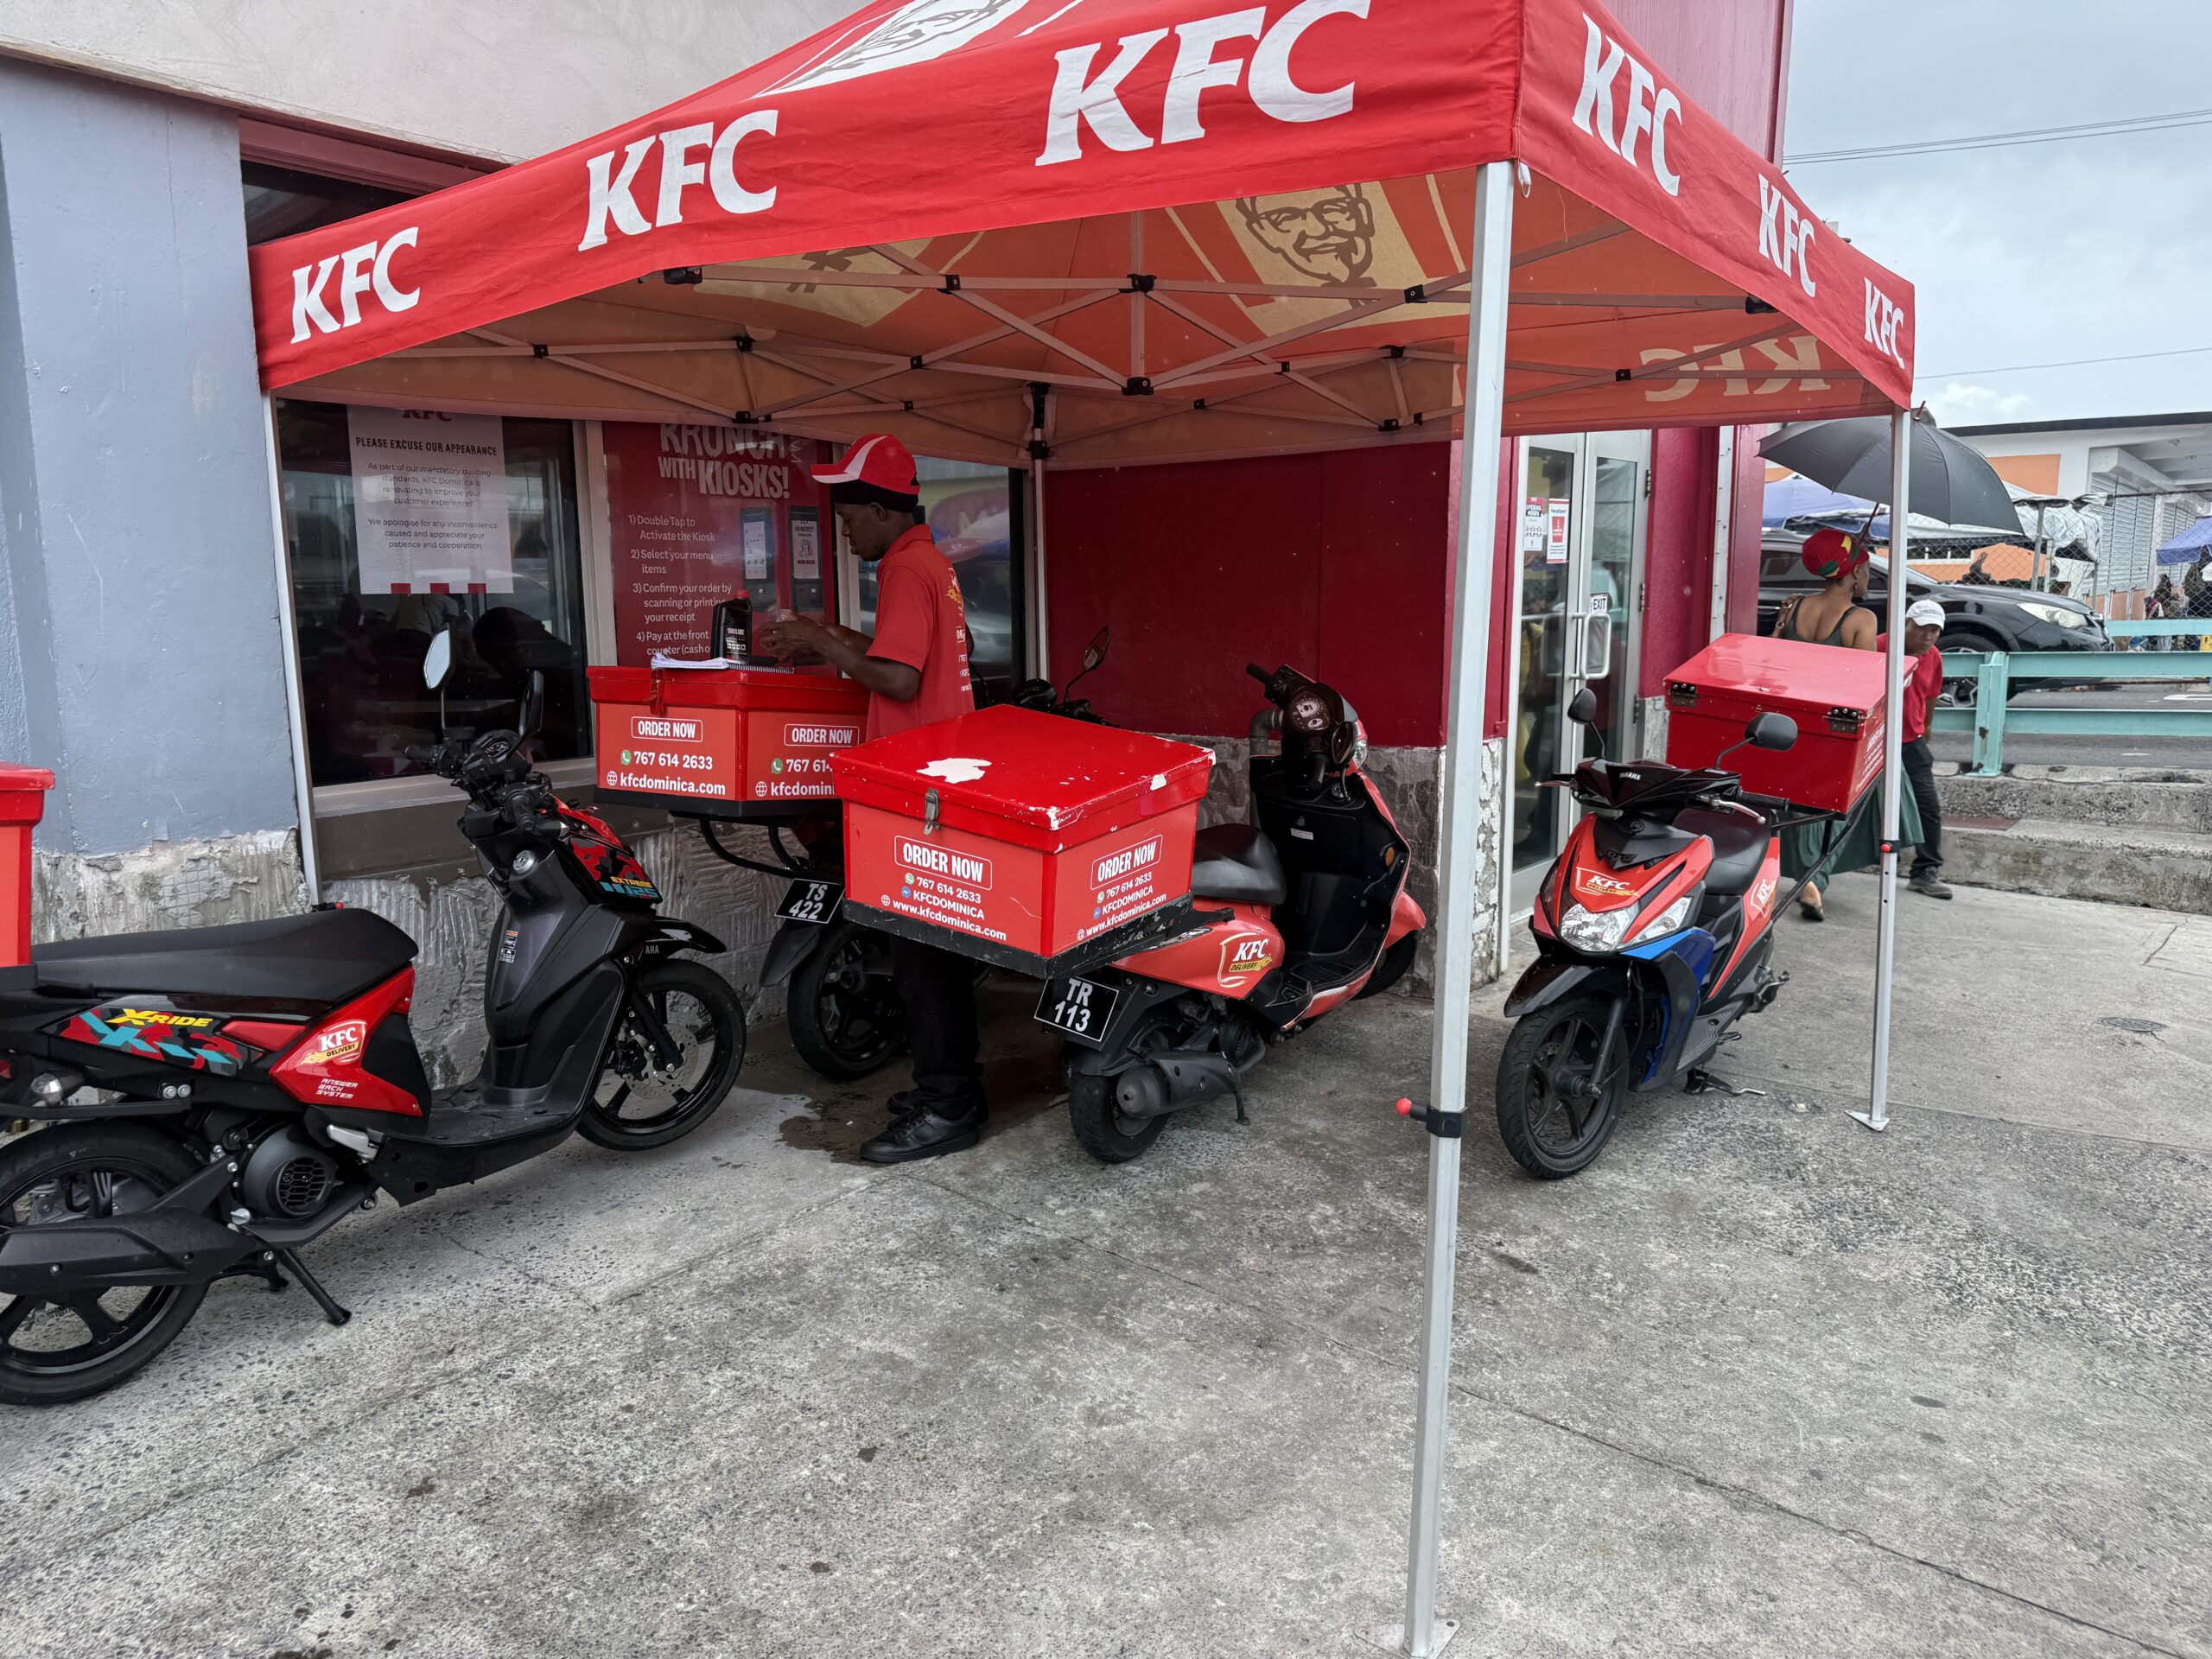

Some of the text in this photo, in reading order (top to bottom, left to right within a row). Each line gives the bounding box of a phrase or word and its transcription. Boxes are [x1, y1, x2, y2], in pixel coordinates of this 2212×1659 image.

[1035, 0, 1369, 166] KFC
[1572, 11, 1682, 197] KFC
[578, 109, 779, 252] KFC
[1758, 173, 1816, 298] KFC
[290, 226, 421, 345] KFC
[1864, 277, 1905, 370] KFC
[355, 436, 497, 456] PLEASE EXCUSE OUR APPEARANCE
[660, 423, 788, 460] KRUNCH
[379, 463, 395, 473] part
[420, 466, 461, 476] mandatory
[461, 468, 491, 478] building
[658, 456, 790, 499] WITH KIOSKS!
[439, 476, 474, 486] Dominica
[383, 486, 423, 496] renovating
[434, 487, 464, 498] improve
[431, 499, 473, 508] experience!
[383, 519, 419, 528] apologise
[447, 521, 499, 530] inconvenience
[628, 514, 696, 528] 1) Double Tap to
[429, 531, 467, 540] appreciate
[639, 530, 715, 542] Activate the Kiosk
[388, 541, 421, 550] patience
[438, 542, 483, 550] cooperation.
[631, 549, 640, 560] 2)
[641, 550, 669, 559] Select
[668, 552, 688, 562] your
[642, 563, 666, 574] items
[632, 583, 732, 595] 3) Confirm your order by
[644, 597, 683, 609] scanning
[1593, 598, 1606, 610] EXIT
[645, 612, 696, 624] your receipt
[636, 631, 645, 642] 4)
[646, 632, 662, 643] Pay
[673, 631, 687, 639] the
[689, 630, 709, 639] front
[682, 644, 703, 654] (cash
[638, 721, 696, 739] ORDER NOW
[791, 728, 853, 744] ORDER NOW
[633, 751, 713, 770] 767 614 2633
[785, 759, 810, 772] 767
[620, 772, 726, 795] kfcdominica.com
[903, 842, 984, 883] ORDER NOW
[1097, 841, 1157, 882] ORDER NOW
[610, 876, 653, 888] EXTREME
[917, 877, 982, 904] 767 614 2633
[1106, 871, 1152, 899] 767 614 2633
[1588, 874, 1630, 891] KFC
[1588, 883, 1618, 893] DELIVERY
[805, 882, 829, 901] TS
[1103, 885, 1154, 915] KFCDOMINICA
[1757, 878, 1771, 905] KFC
[788, 899, 823, 920] 422
[913, 890, 985, 920] KFCDOMINICA
[893, 899, 1007, 941] www.kfcdominica.com
[1086, 893, 1166, 937] www.kfcdominica.com
[1232, 938, 1269, 962] KFC
[1230, 962, 1258, 971] DELIVERY
[1068, 978, 1093, 1007] TR
[1054, 1001, 1091, 1033] 113
[320, 1027, 358, 1052] KFC
[327, 1043, 356, 1057] DELIVERY
[321, 1078, 359, 1088] ANSWER
[315, 1090, 354, 1099] SYSTEM
